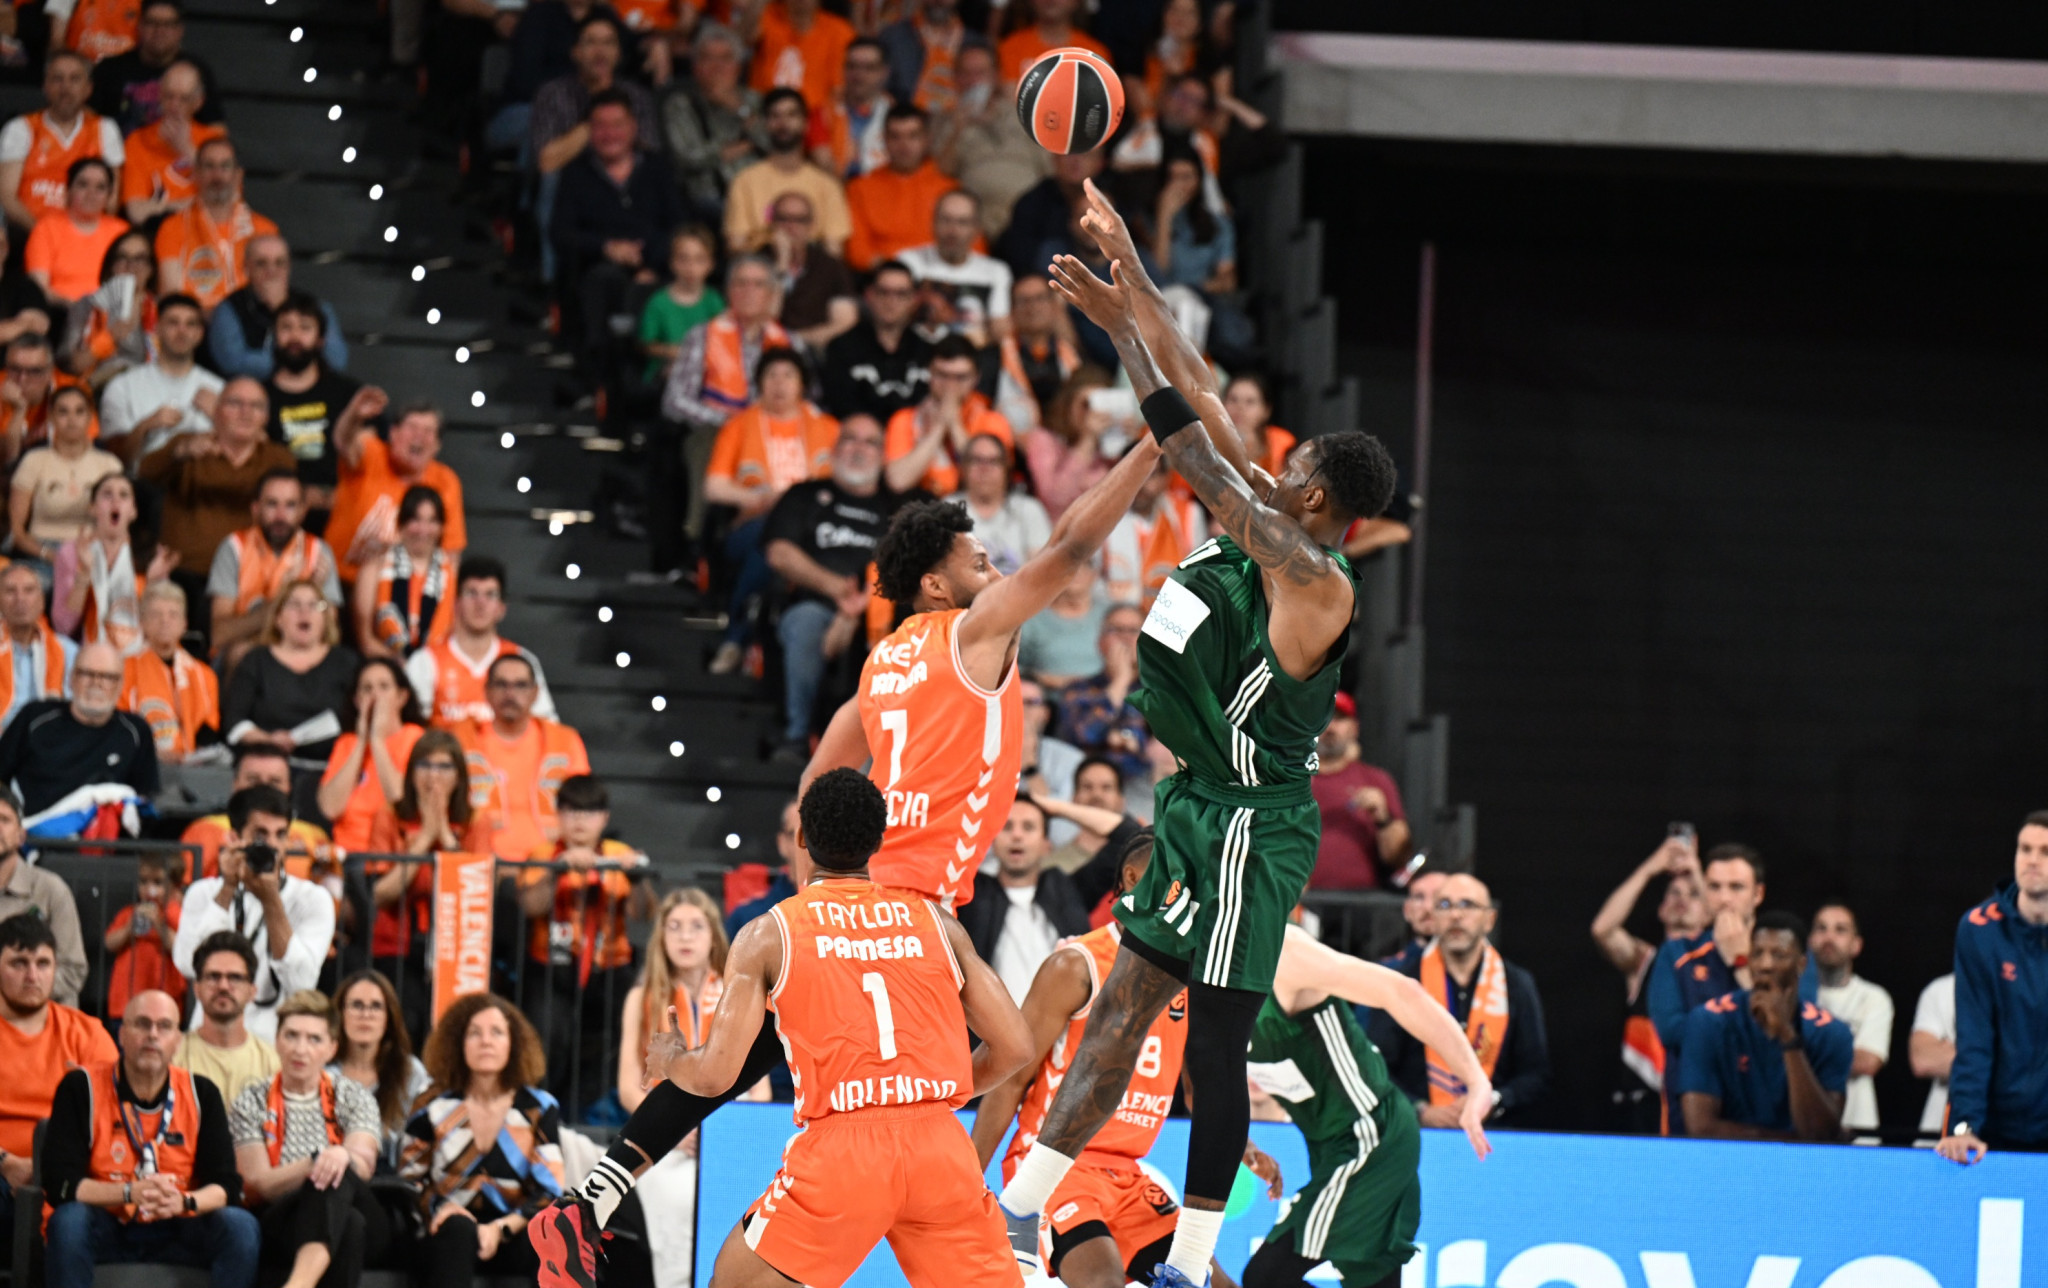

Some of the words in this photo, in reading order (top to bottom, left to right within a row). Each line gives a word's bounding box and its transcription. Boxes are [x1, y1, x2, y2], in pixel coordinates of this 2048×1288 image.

[873, 628, 930, 668] KEY
[880, 709, 907, 791] 7
[808, 901, 914, 930] TAYLOR
[1163, 886, 1201, 937] 11
[815, 935, 924, 961] PAMESA
[862, 972, 898, 1061] 1
[1135, 1035, 1162, 1079] 8
